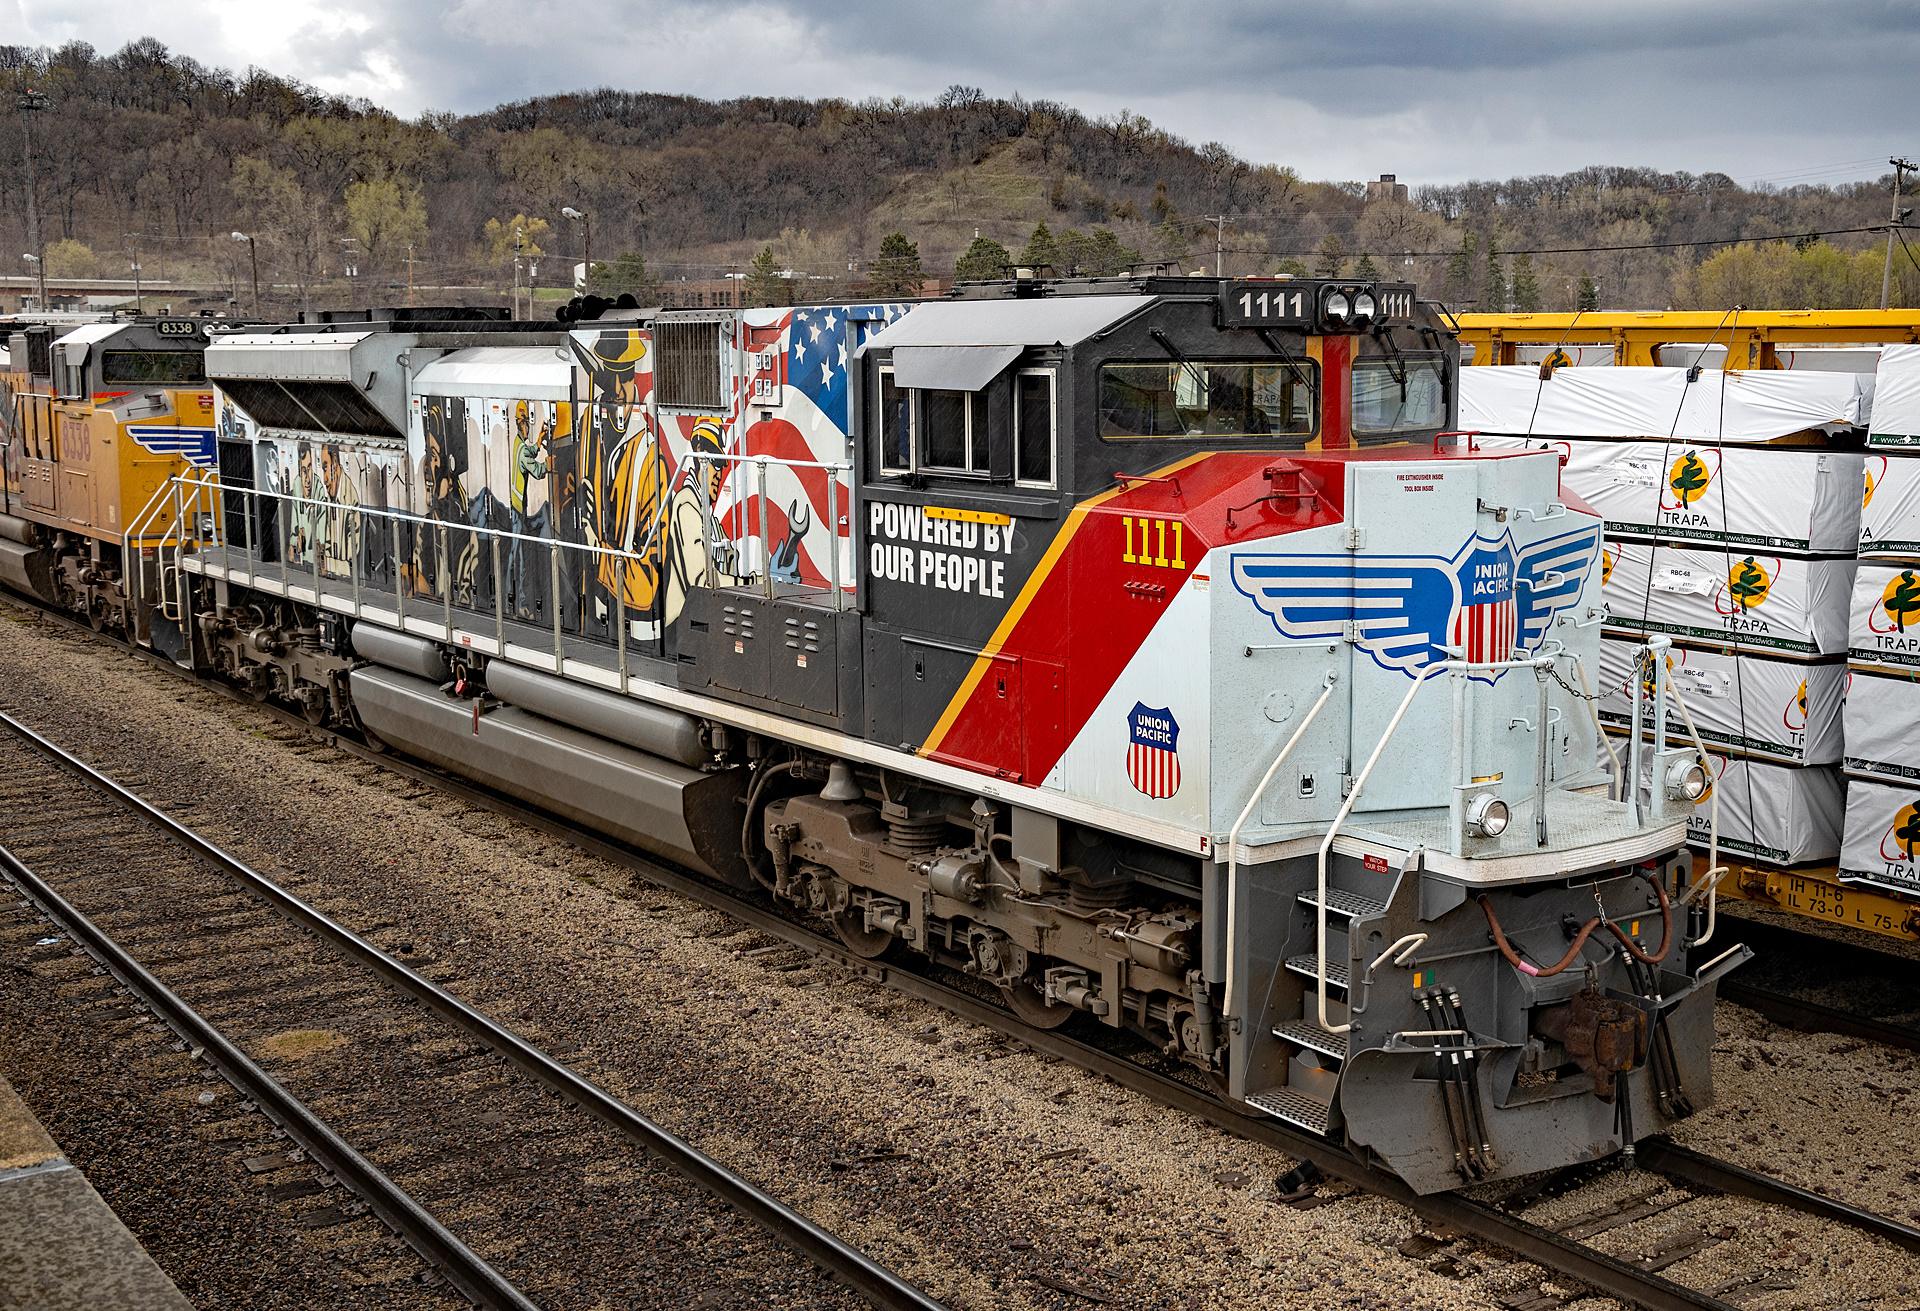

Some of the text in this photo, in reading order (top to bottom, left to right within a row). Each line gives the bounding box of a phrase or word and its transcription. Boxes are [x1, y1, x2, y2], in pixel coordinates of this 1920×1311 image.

[1239, 292, 1302, 318] 1111
[1380, 293, 1411, 318] 1111
[162, 322, 192, 333] 8338
[62, 420, 91, 462] 8338
[870, 501, 1016, 555] POWERED BY
[1664, 512, 1710, 528] TRAPA
[1122, 516, 1186, 570] 1111
[1685, 530, 1715, 540] Worldwide
[870, 542, 1005, 599] OUR PEOPLE
[1721, 616, 1769, 634] TRAPA
[1703, 630, 1725, 639] Lumber
[1743, 635, 1776, 647] Worldwide
[1875, 635, 1920, 652] TRAP
[1137, 714, 1170, 732] UNION
[1136, 726, 1172, 745] PACIFIC
[1200, 836, 1208, 852] F
[1884, 861, 1920, 881] TRA
[1790, 878, 1844, 902] IH 11-6
[1788, 893, 1801, 908] IL
[1808, 898, 1844, 918] 73-0
[1856, 909, 1865, 924] L
